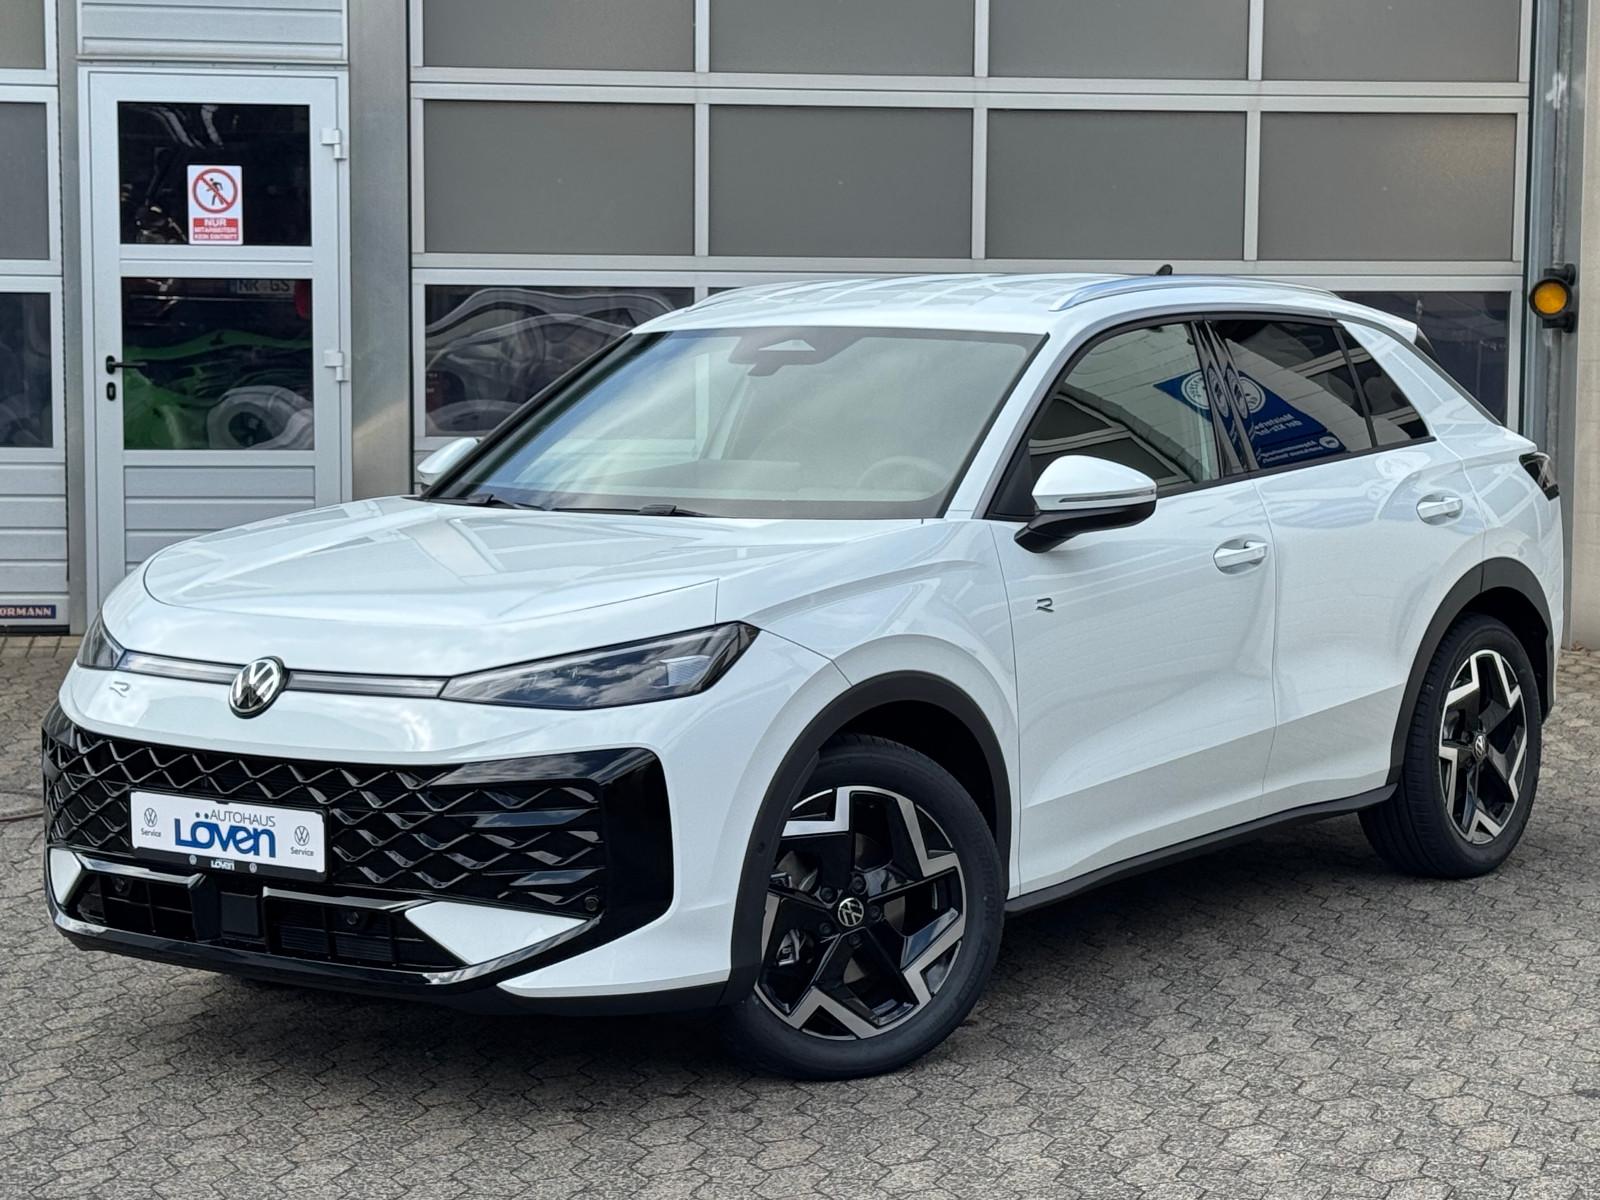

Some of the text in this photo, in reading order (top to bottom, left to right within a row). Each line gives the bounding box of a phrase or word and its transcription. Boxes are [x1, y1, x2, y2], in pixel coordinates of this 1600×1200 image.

[204, 218, 227, 227] NUR
[210, 809, 276, 827] AUTOHAUS
[140, 828, 161, 838] Service
[290, 846, 315, 857] Service
